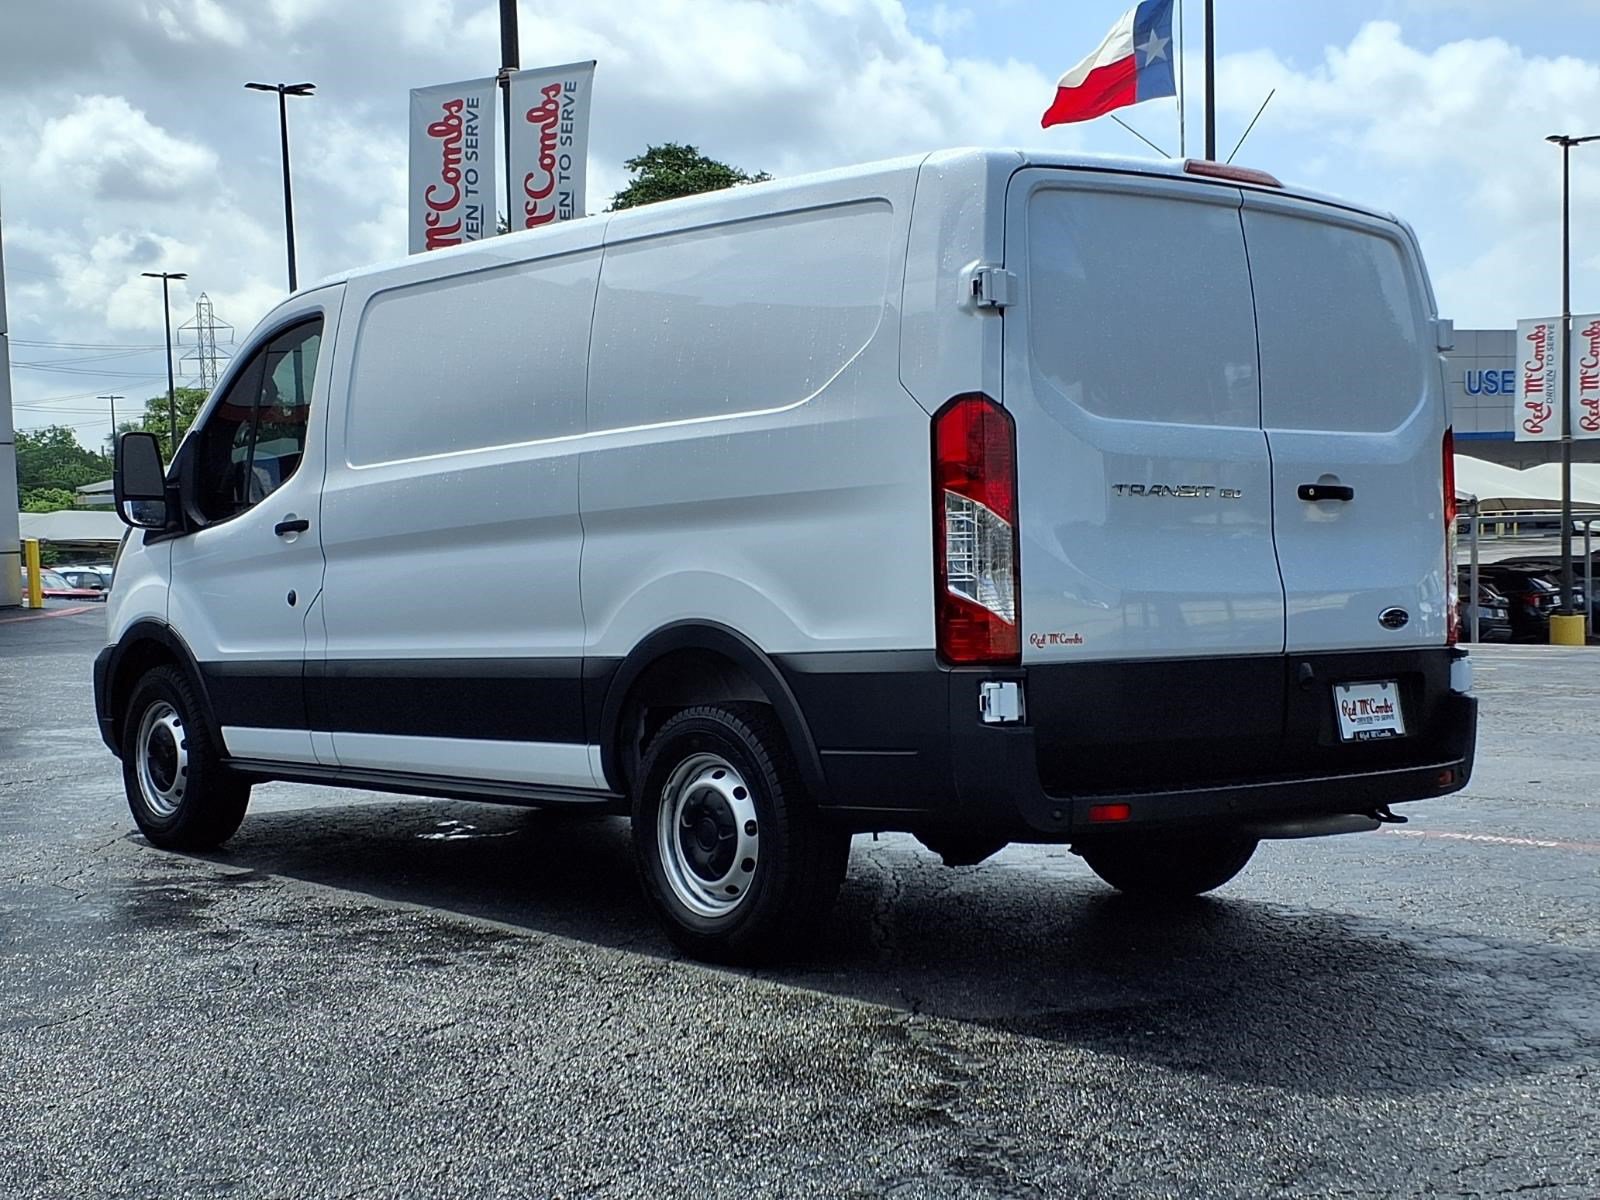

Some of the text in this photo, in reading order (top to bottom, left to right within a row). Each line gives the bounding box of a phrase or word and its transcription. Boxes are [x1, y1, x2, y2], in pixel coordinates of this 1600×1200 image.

[559, 80, 577, 147] SERVE
[464, 97, 480, 162] SERVE
[464, 169, 479, 198] TO
[558, 154, 572, 184] TO
[1545, 323, 1556, 404] DRIVEN TO SERVE
[1466, 370, 1515, 394] USE
[1523, 402, 1552, 434] Red
[1579, 398, 1600, 432] Red
[1111, 484, 1216, 498] TRANSIT
[1029, 632, 1046, 649] Red
[1341, 699, 1357, 723] Red
